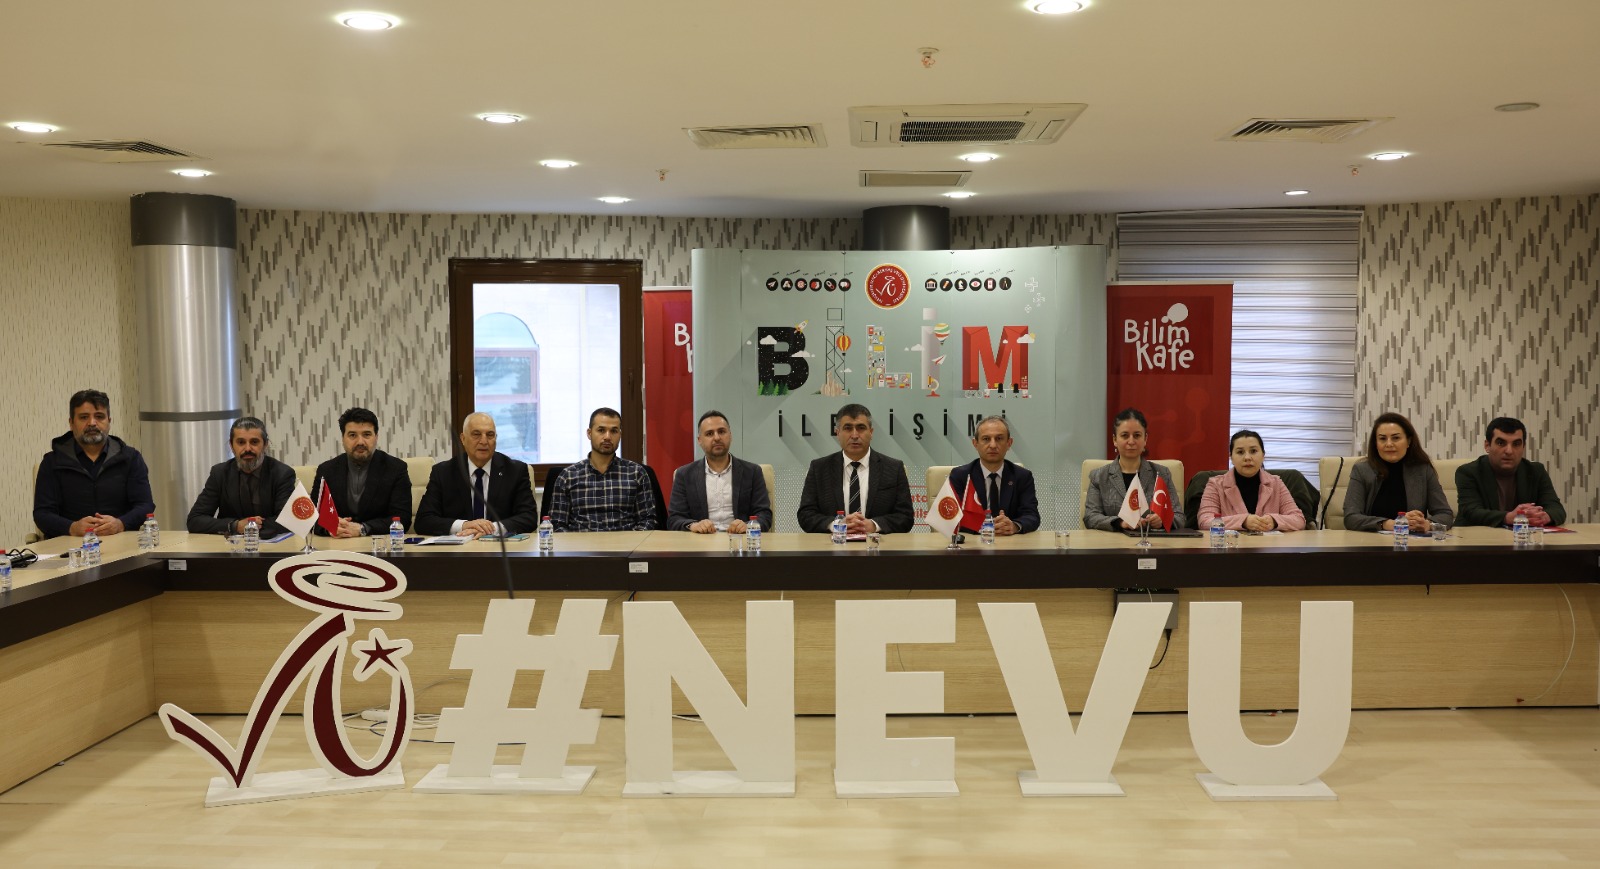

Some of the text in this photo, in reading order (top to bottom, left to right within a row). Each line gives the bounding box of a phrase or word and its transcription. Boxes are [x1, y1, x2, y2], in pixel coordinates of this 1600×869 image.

[1124, 318, 1190, 345] Bilim
[1136, 339, 1195, 371] Kafe
[434, 599, 1354, 785] #NEVU
